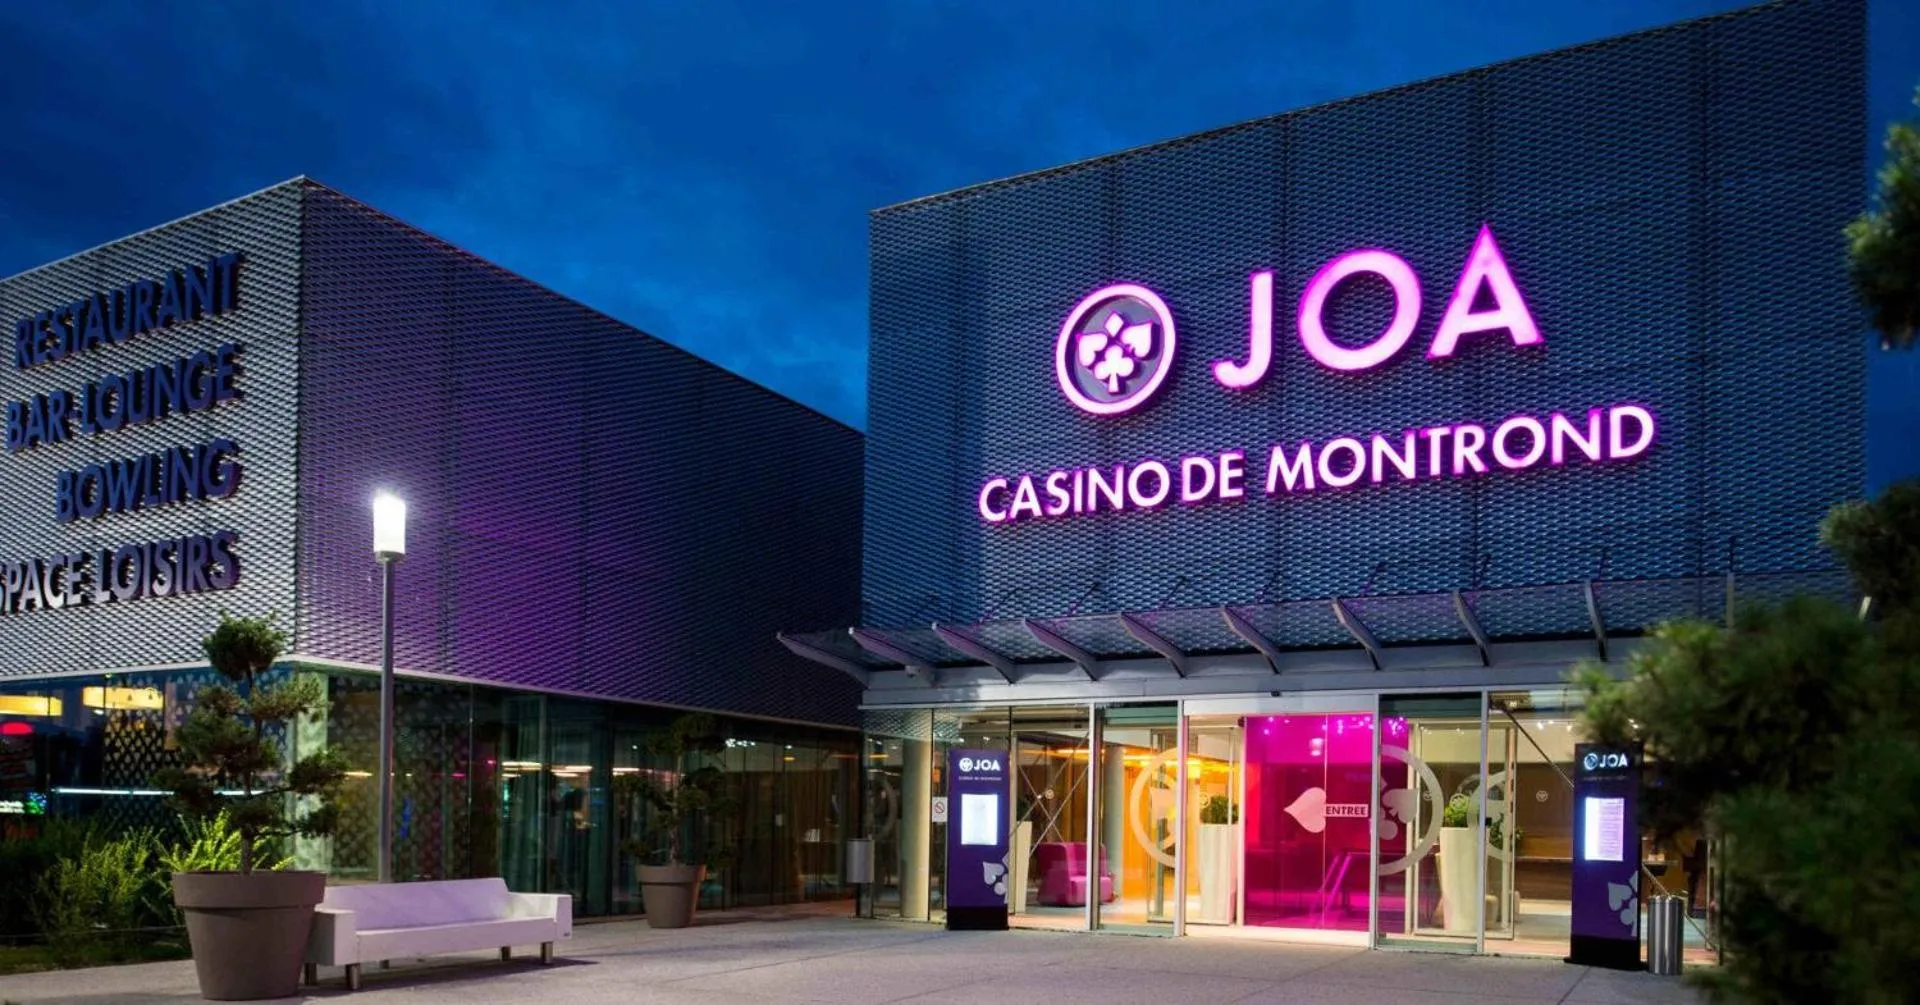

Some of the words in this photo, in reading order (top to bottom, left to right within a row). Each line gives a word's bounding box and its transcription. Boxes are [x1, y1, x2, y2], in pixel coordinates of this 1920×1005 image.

[15, 252, 240, 368] RESTAURANT
[1212, 223, 1543, 389] JOA
[56, 437, 242, 524] BOWLING
[979, 461, 1171, 522] CASINO
[1181, 450, 1244, 503] DE
[1265, 403, 1656, 494] MONTROND
[0, 552, 84, 615] PACE
[96, 530, 238, 600] LOISIRS
[973, 759, 1000, 771] JOA
[1600, 754, 1628, 767] JOA
[1326, 806, 1366, 815] ENTREE
